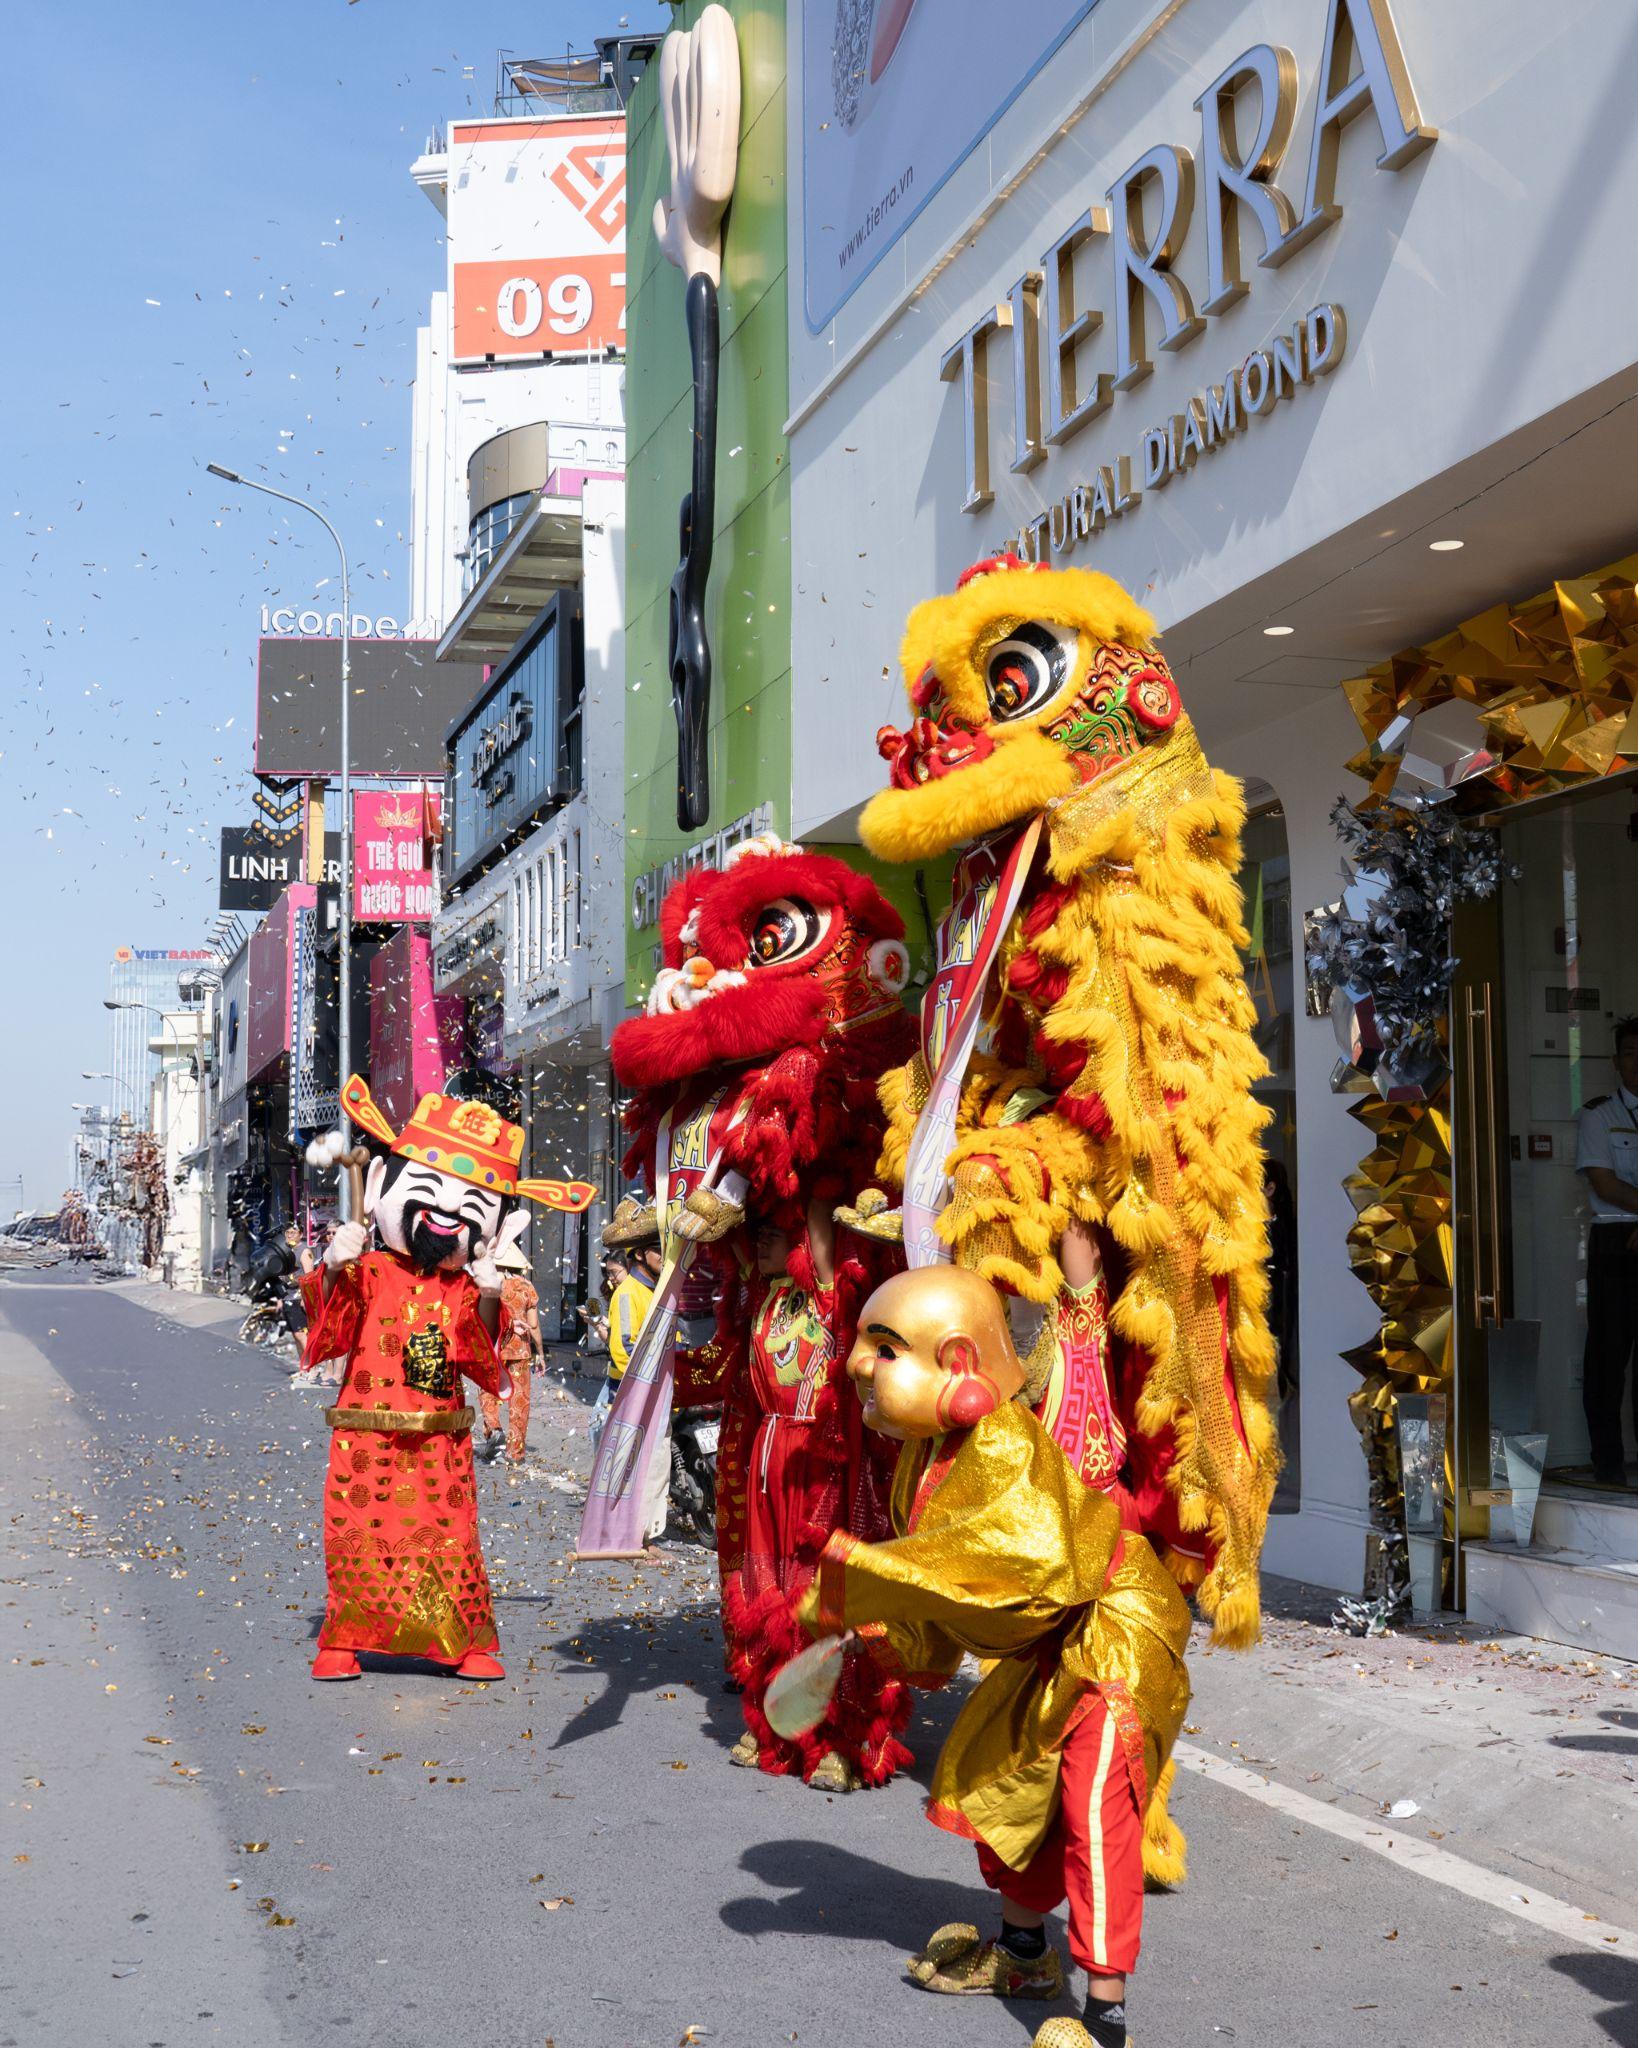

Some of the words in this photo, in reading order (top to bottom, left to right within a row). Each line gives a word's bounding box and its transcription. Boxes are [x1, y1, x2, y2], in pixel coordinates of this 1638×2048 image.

[839, 165, 914, 269] www.tierra.vn
[940, 0, 1438, 514] TIERRA
[991, 455, 1143, 562] ATURAL
[1143, 302, 1348, 491] DIAMOND
[228, 855, 288, 881] LINH
[135, 950, 213, 960] VIETBANK
